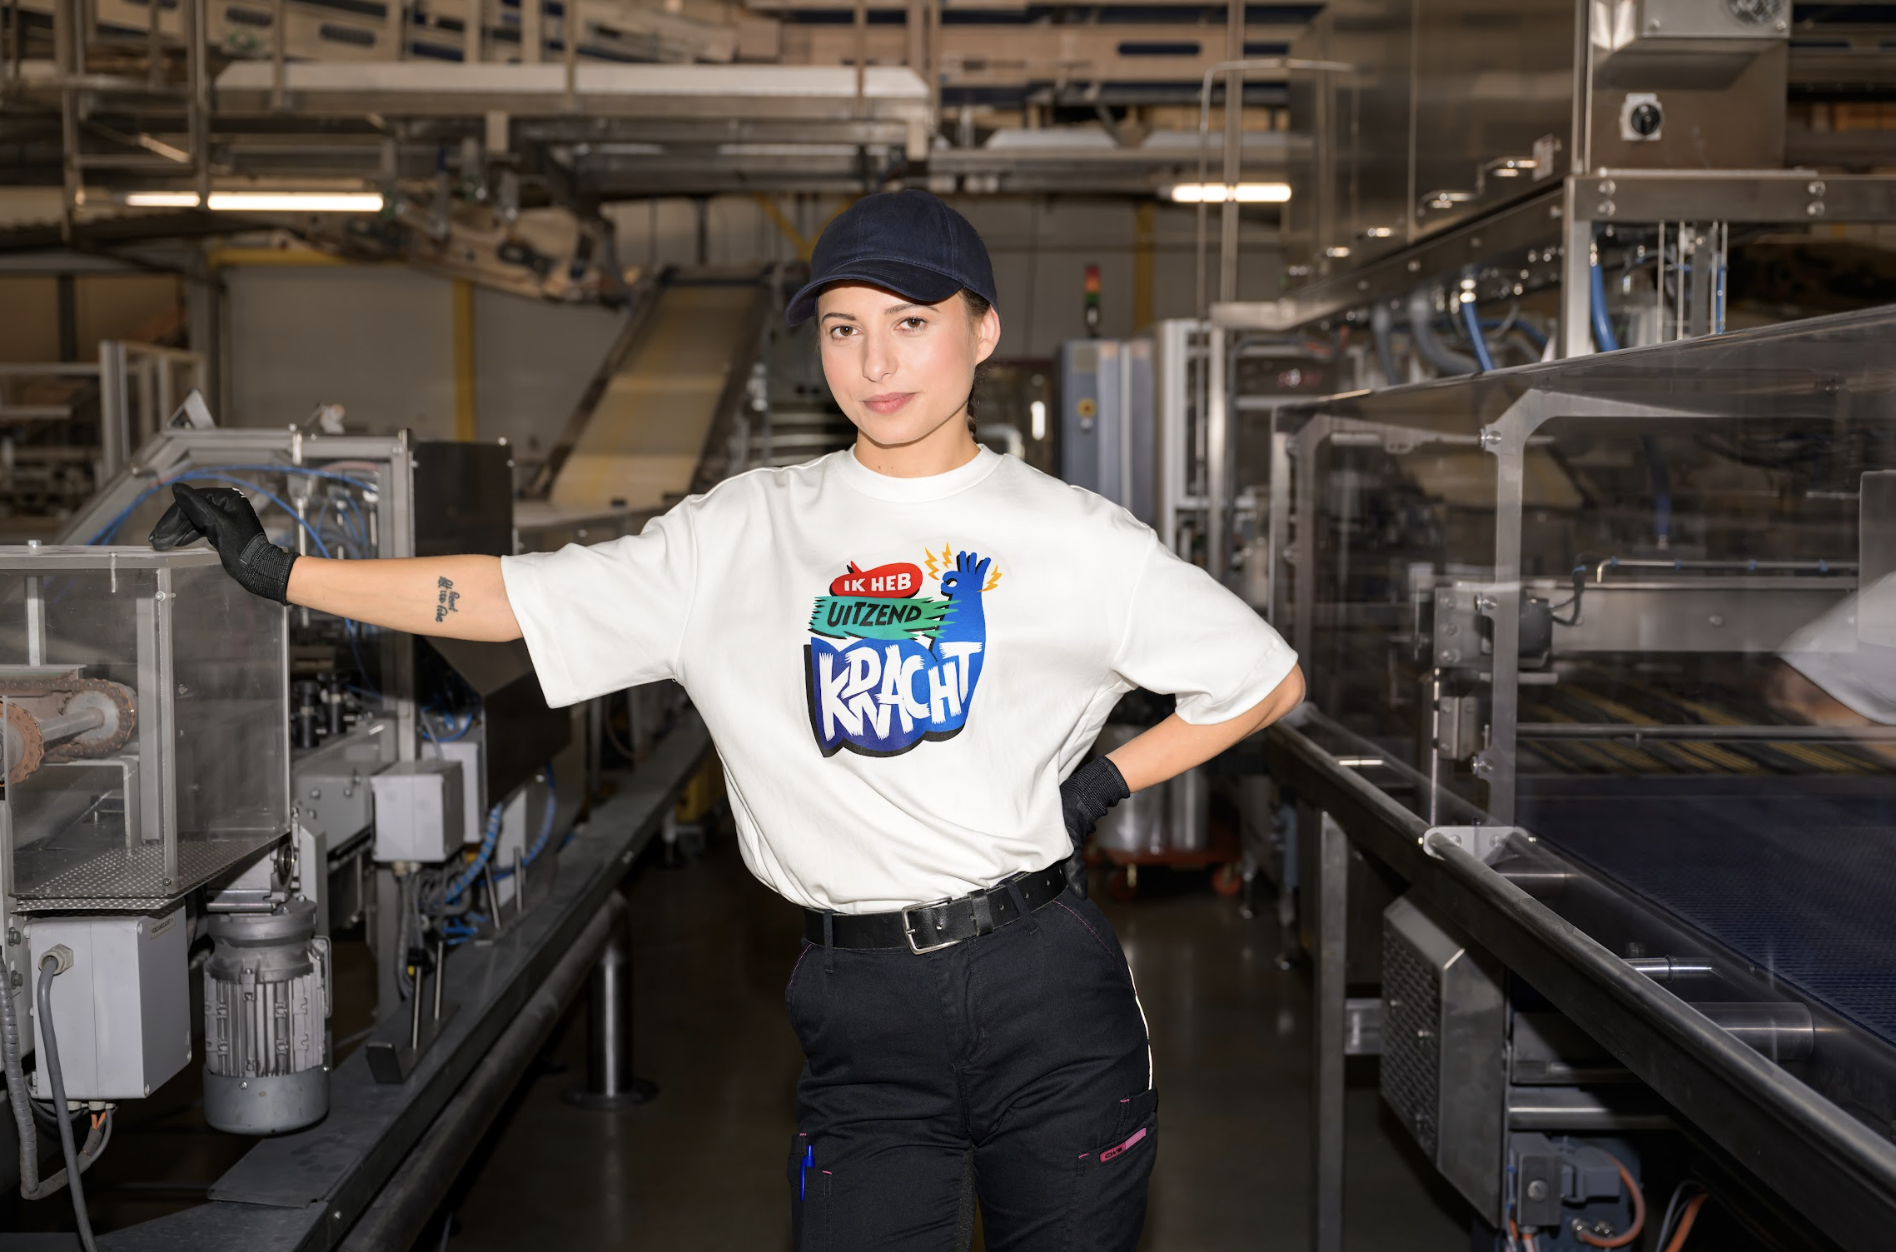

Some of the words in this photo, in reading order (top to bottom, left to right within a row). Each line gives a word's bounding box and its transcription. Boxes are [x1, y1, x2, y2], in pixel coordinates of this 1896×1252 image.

[844, 578, 866, 592] IK
[871, 573, 912, 592] HEB
[827, 601, 922, 627] UITZEND
[818, 641, 983, 742] KRACHT
